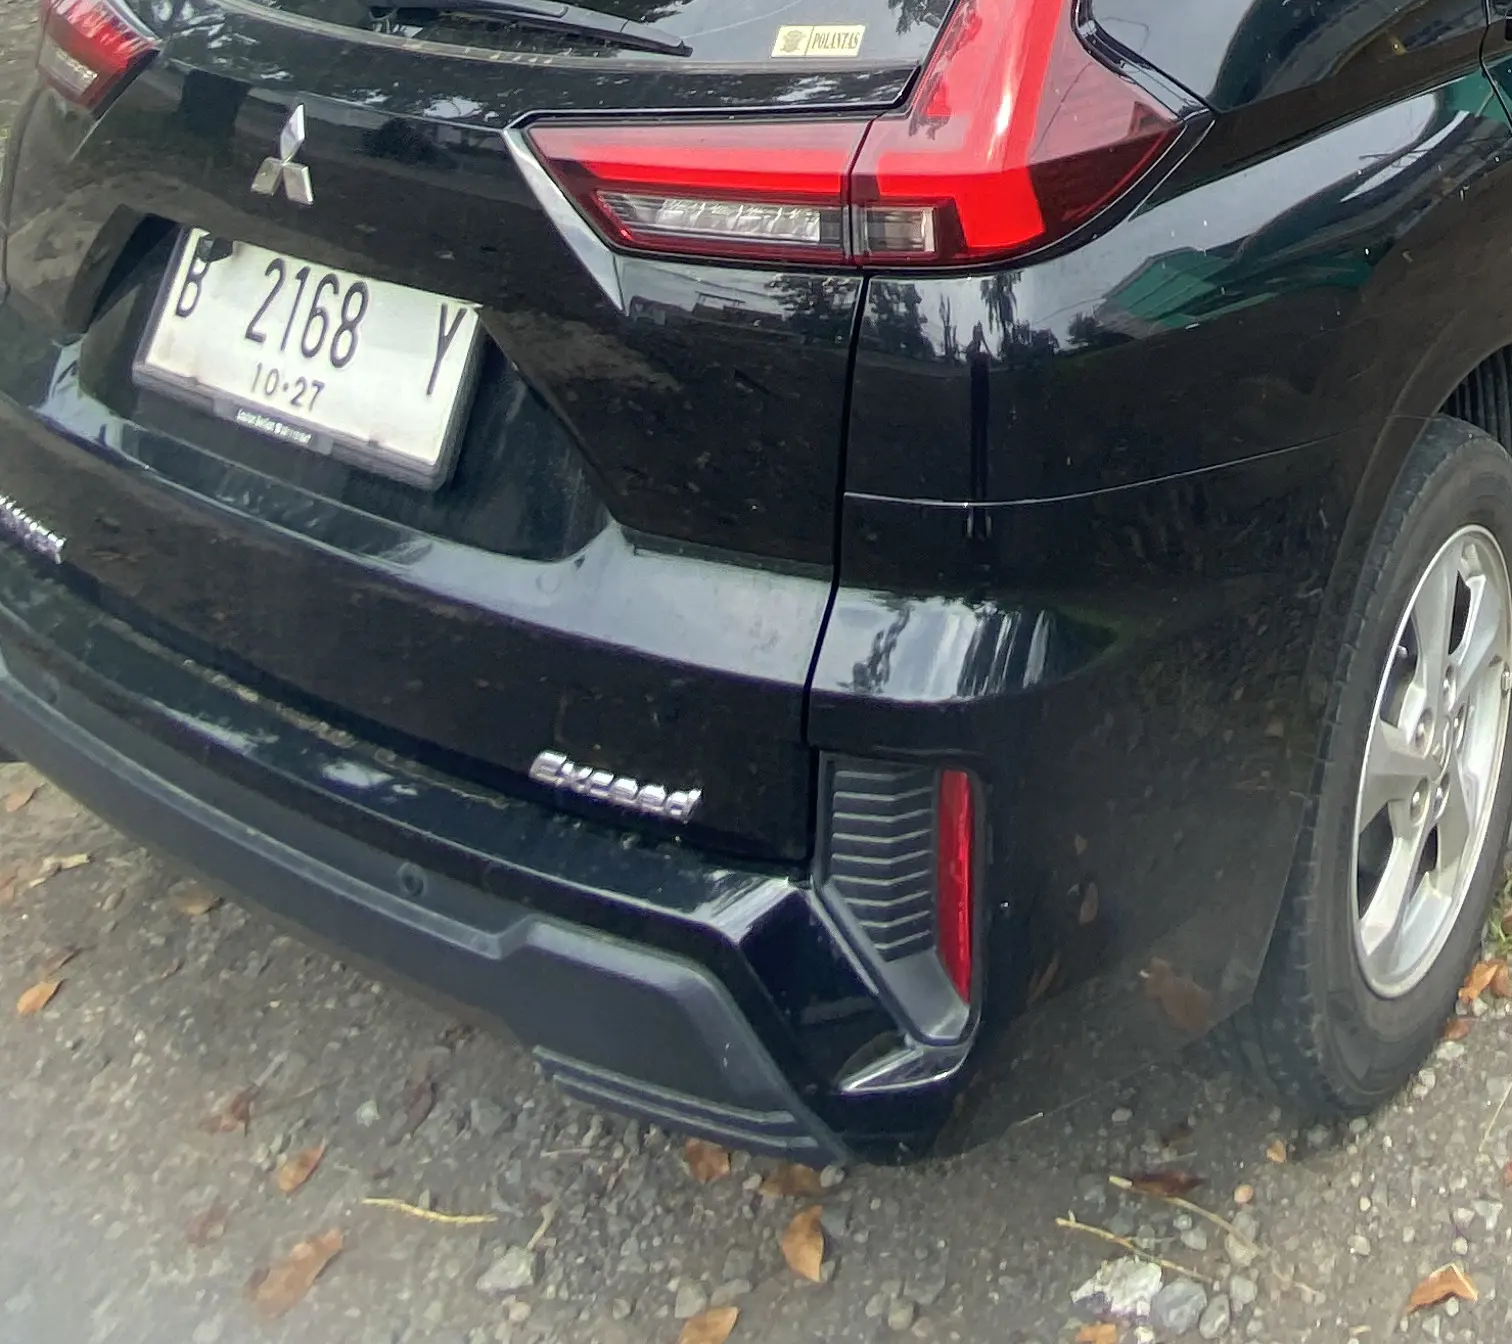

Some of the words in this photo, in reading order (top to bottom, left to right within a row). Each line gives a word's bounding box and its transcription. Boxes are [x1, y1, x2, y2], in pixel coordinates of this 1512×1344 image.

[245, 258, 370, 369] 2168
[426, 302, 468, 396] Y
[529, 749, 702, 824] Exceed
